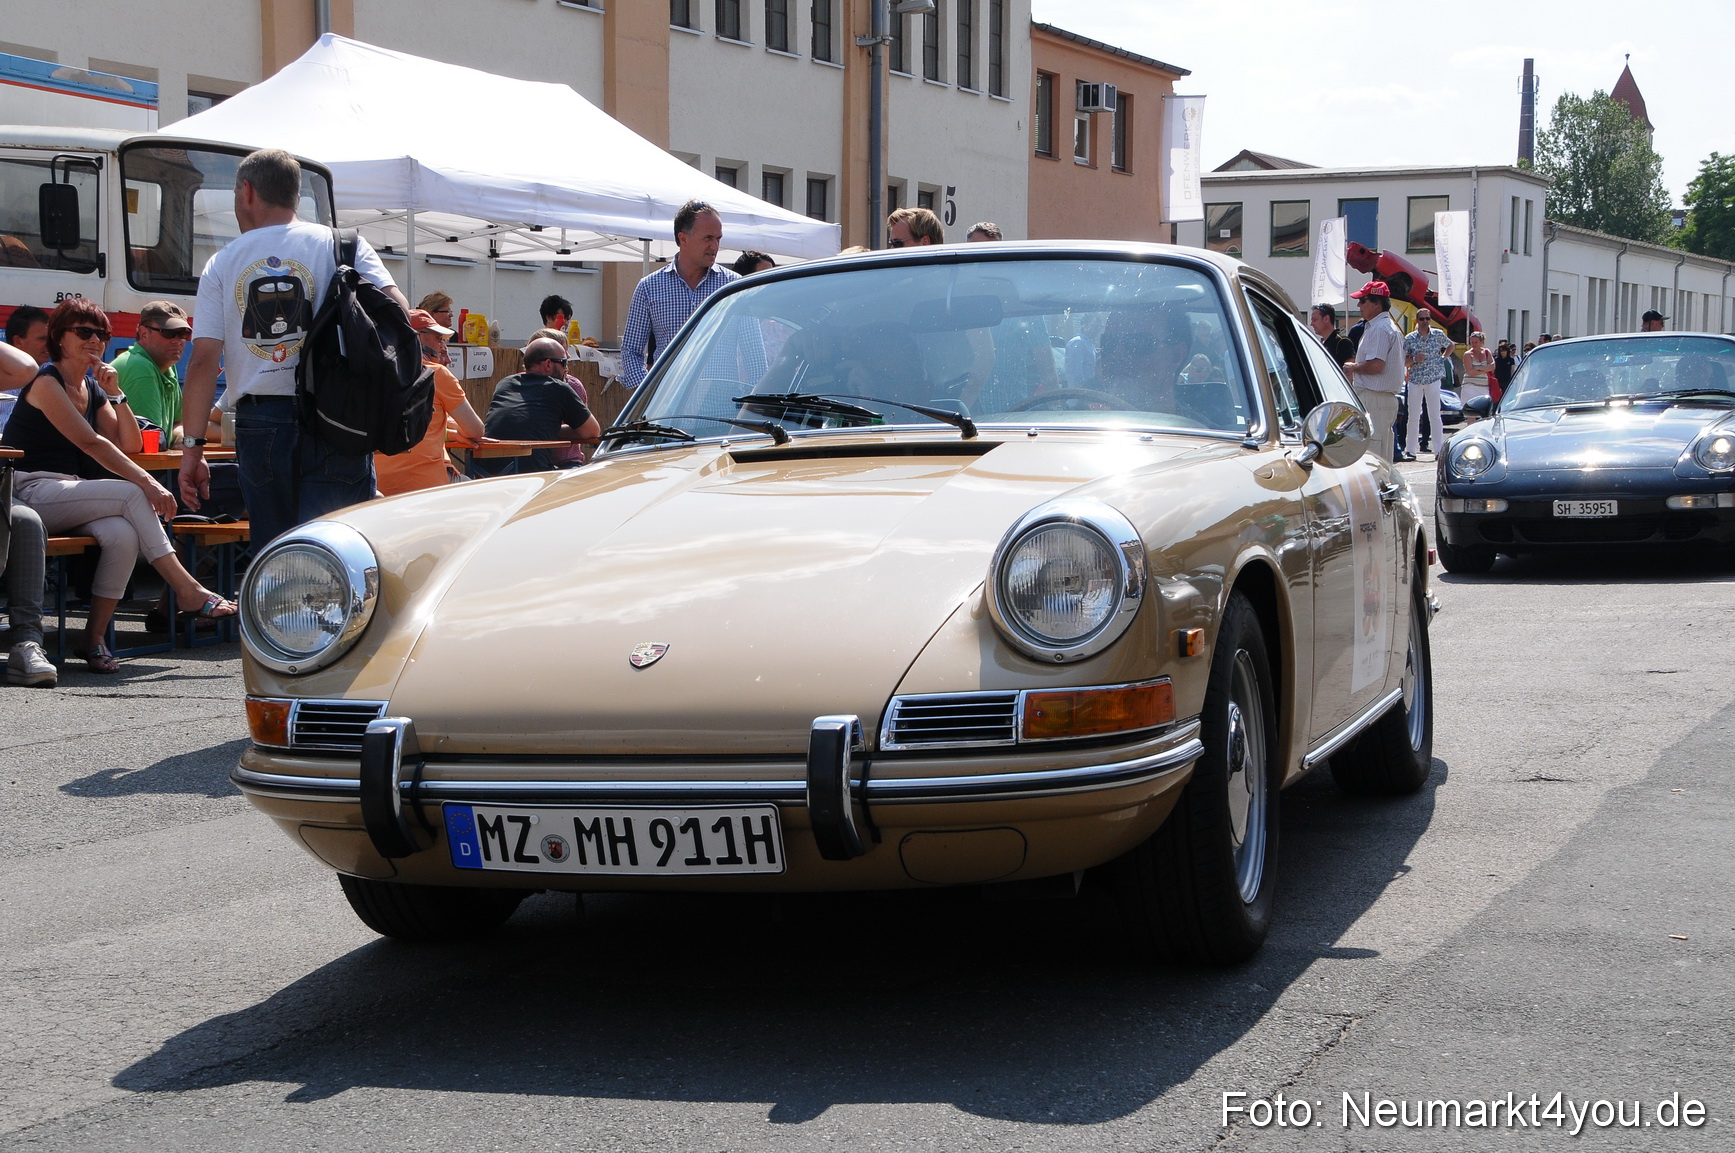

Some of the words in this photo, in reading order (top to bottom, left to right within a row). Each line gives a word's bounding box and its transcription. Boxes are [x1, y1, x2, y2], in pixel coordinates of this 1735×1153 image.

[1184, 122, 1193, 200] OFENWERK
[945, 185, 956, 227] 5
[1557, 503, 1571, 515] SH
[1579, 502, 1613, 515] 35951
[460, 843, 471, 856] D
[477, 813, 540, 865] MZ
[573, 816, 639, 867] MH
[649, 814, 777, 868] 911H
